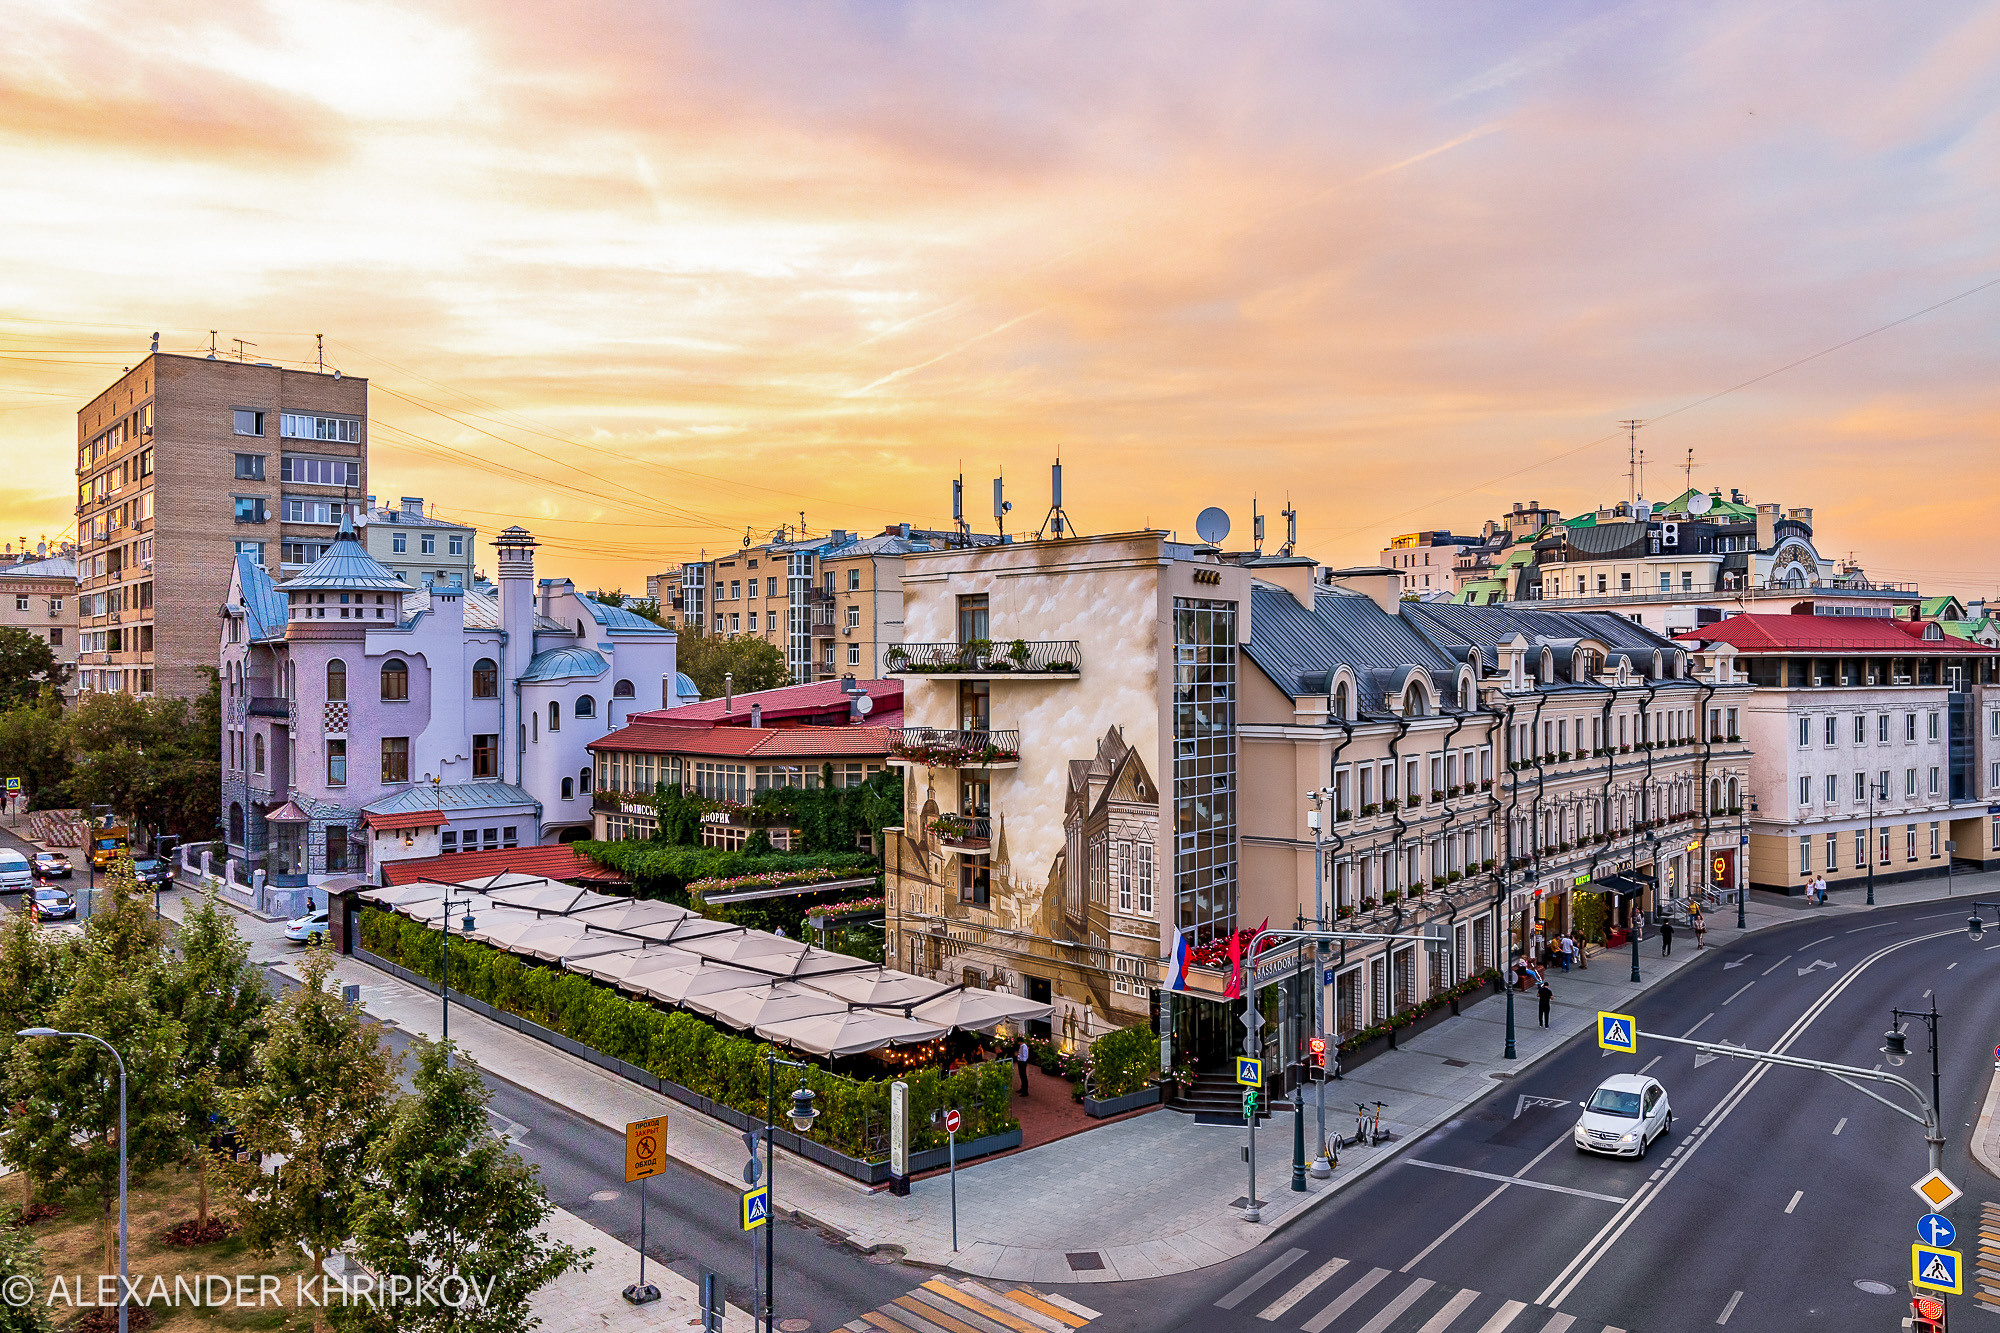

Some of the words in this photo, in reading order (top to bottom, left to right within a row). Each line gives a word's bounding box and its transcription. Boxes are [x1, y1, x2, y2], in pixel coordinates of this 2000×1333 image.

[635, 1120, 660, 1130] ПРОХОД
[635, 1127, 660, 1137] ЗАКРЫТ
[635, 1158, 657, 1169] ОБХОД
